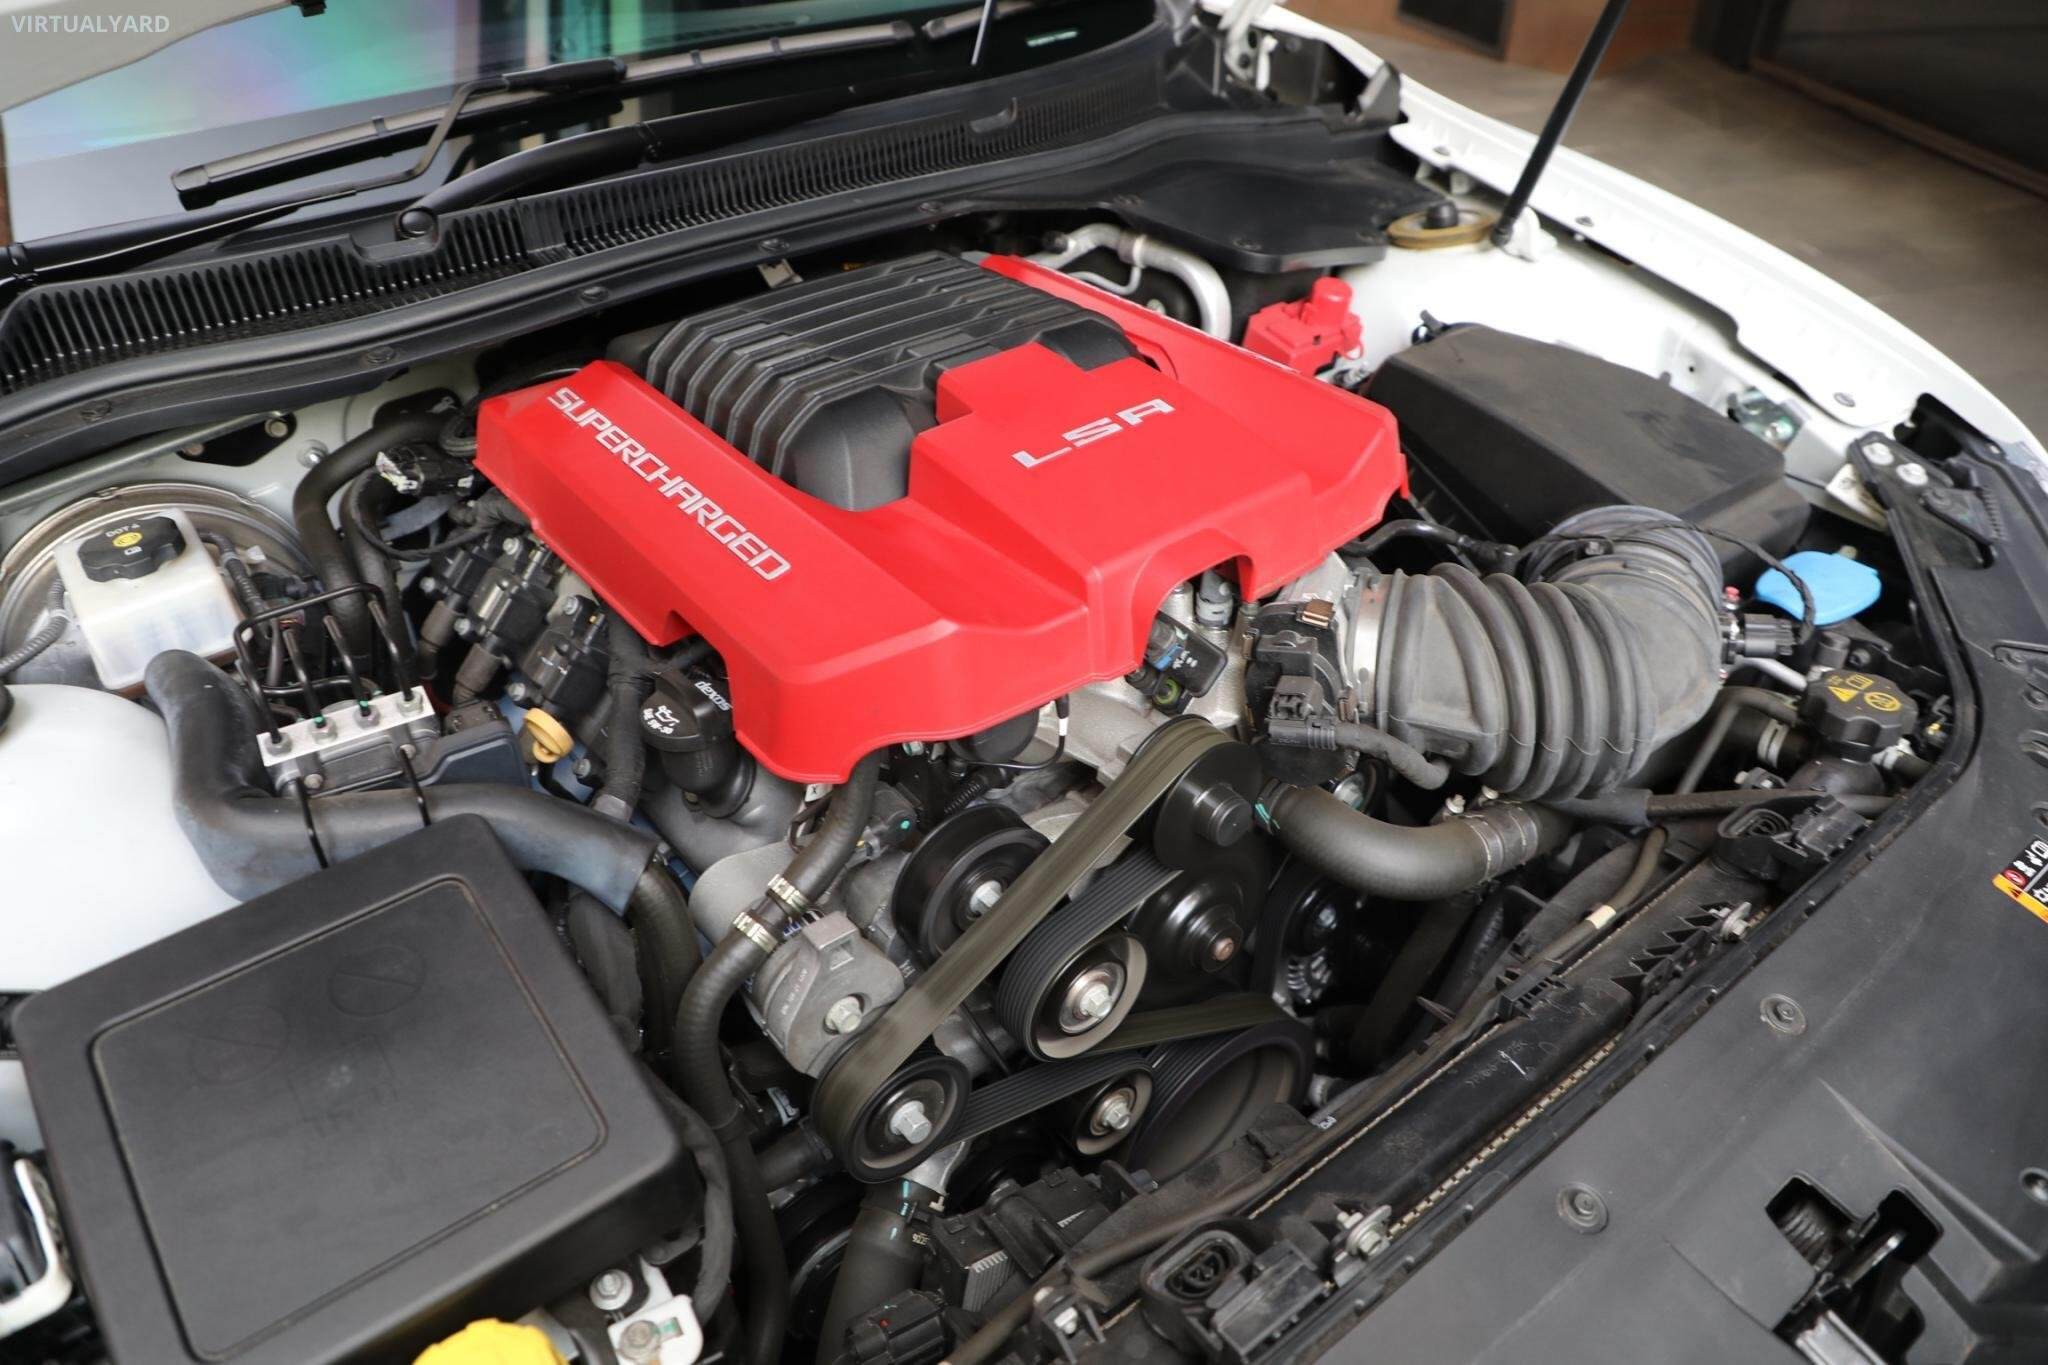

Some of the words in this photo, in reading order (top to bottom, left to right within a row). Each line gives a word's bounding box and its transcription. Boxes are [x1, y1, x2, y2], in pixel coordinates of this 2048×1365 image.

[1011, 398, 1175, 468] LSA
[547, 387, 791, 581] SUPERCHARGED
[694, 681, 734, 711] dexos
